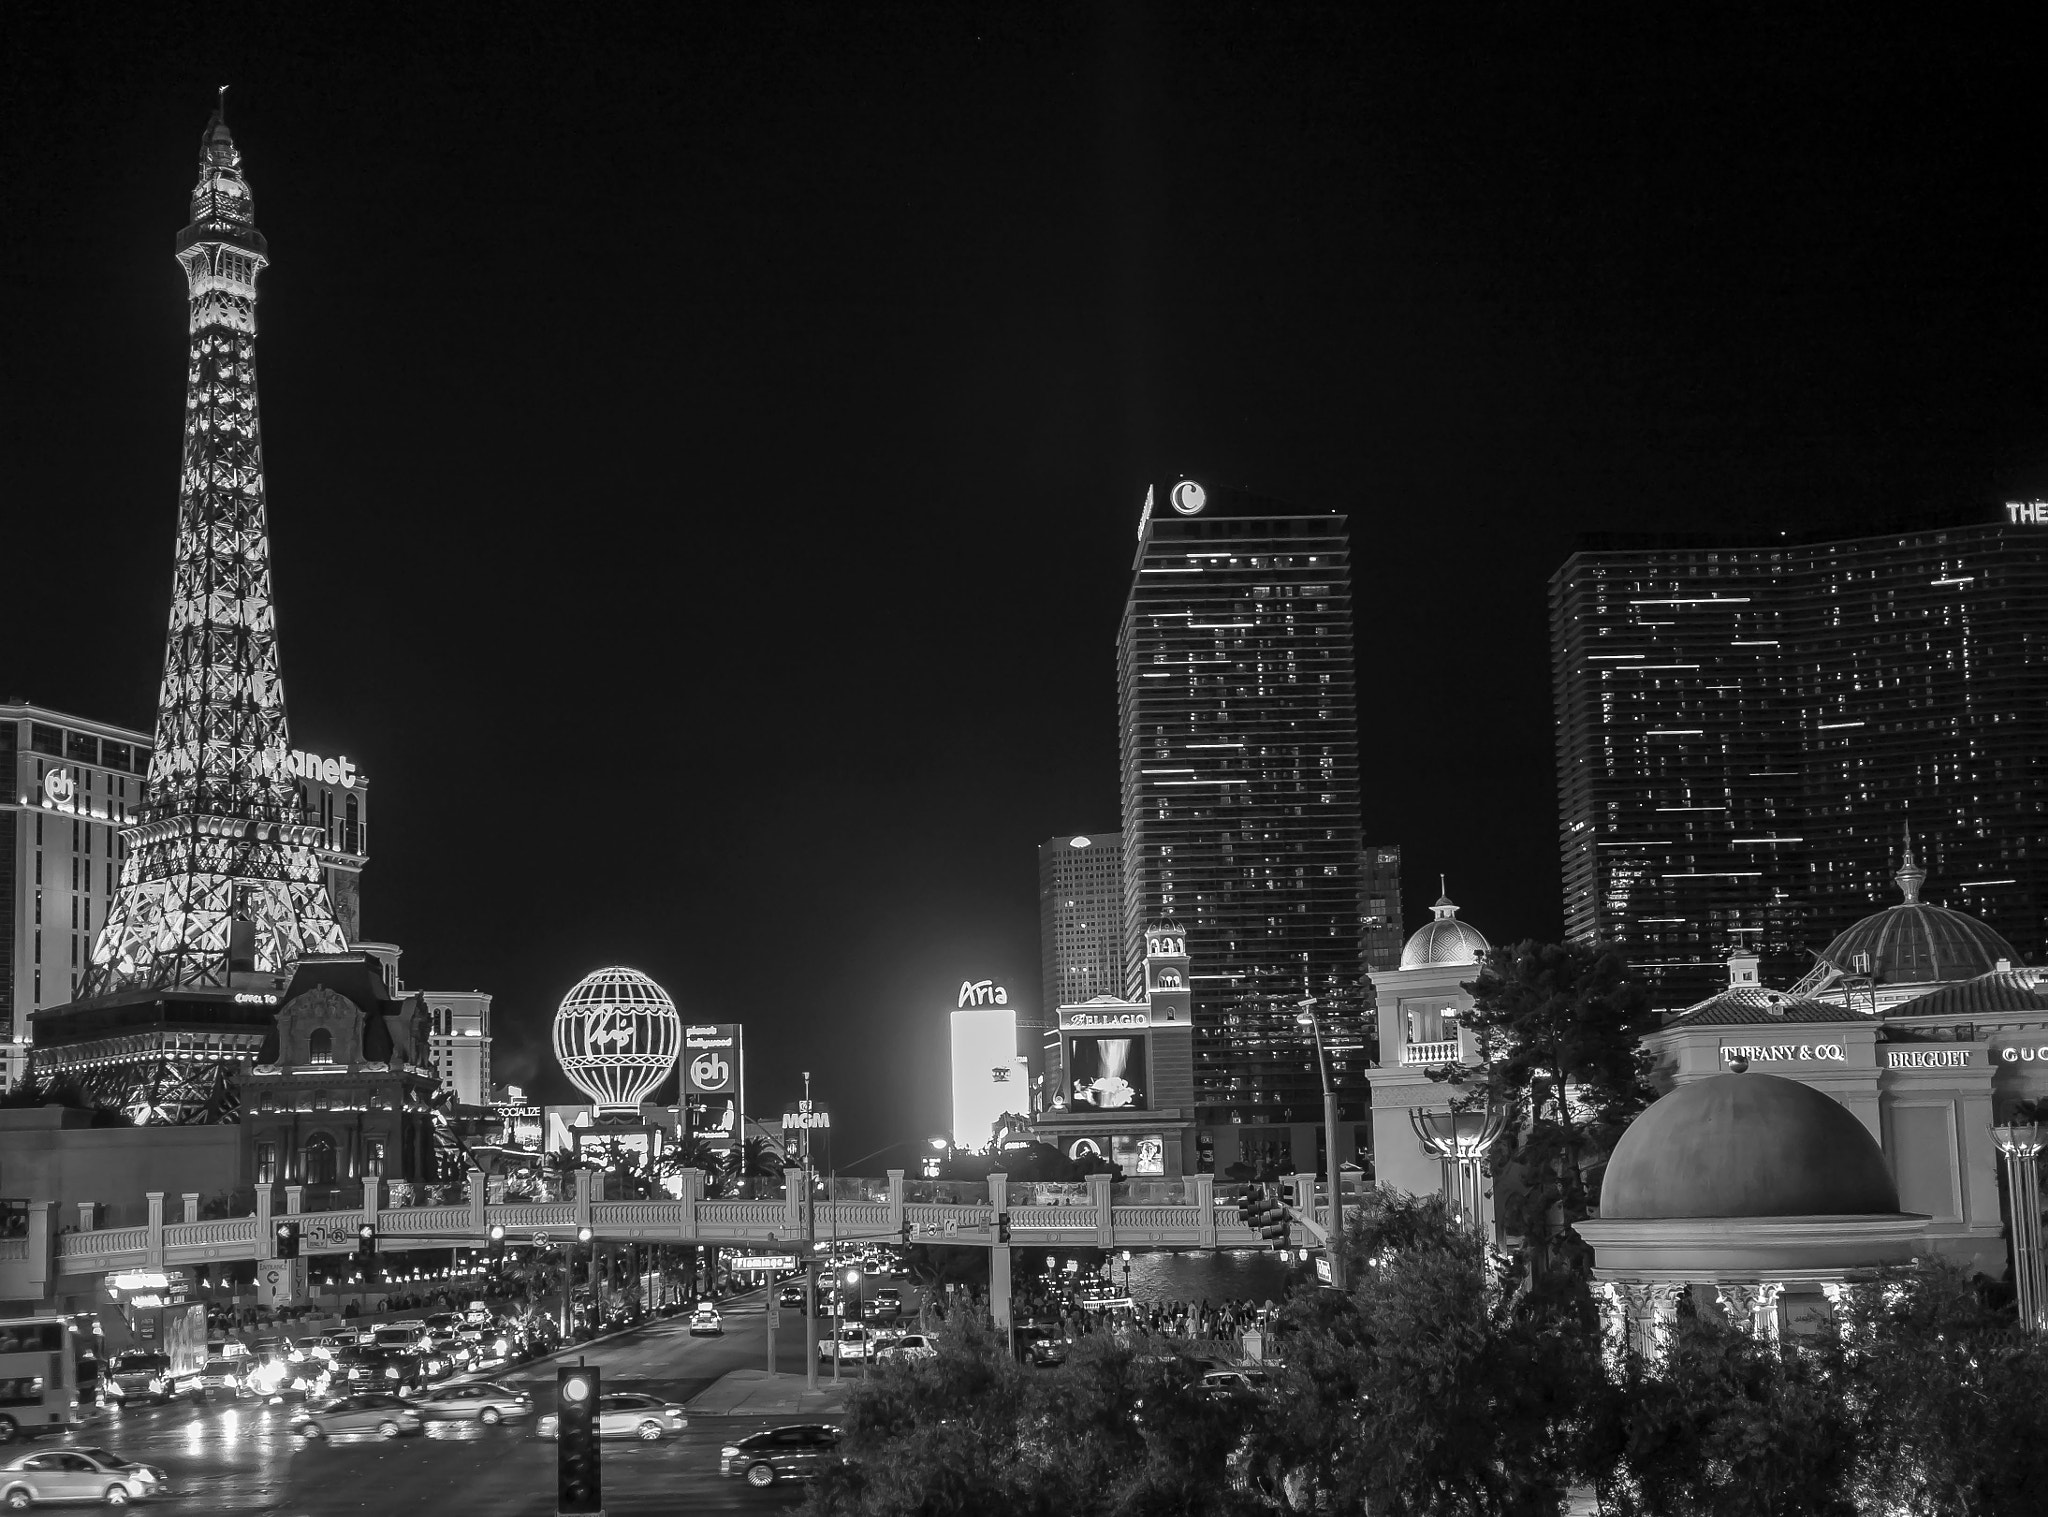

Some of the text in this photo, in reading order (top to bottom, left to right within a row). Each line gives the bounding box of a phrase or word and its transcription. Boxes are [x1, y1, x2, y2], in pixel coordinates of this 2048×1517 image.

[2006, 502, 2048, 524] THE
[286, 749, 356, 788] anet
[45, 768, 74, 803] ph
[264, 994, 277, 1004] TO
[958, 980, 1008, 1008] Aria
[1799, 1044, 1812, 1060] &
[1888, 1050, 1969, 1069] BREGUET
[690, 1053, 729, 1091] ph
[782, 1113, 830, 1128] MGM
[737, 1257, 783, 1269] Flamingo
[295, 1255, 303, 1299] LLYS
